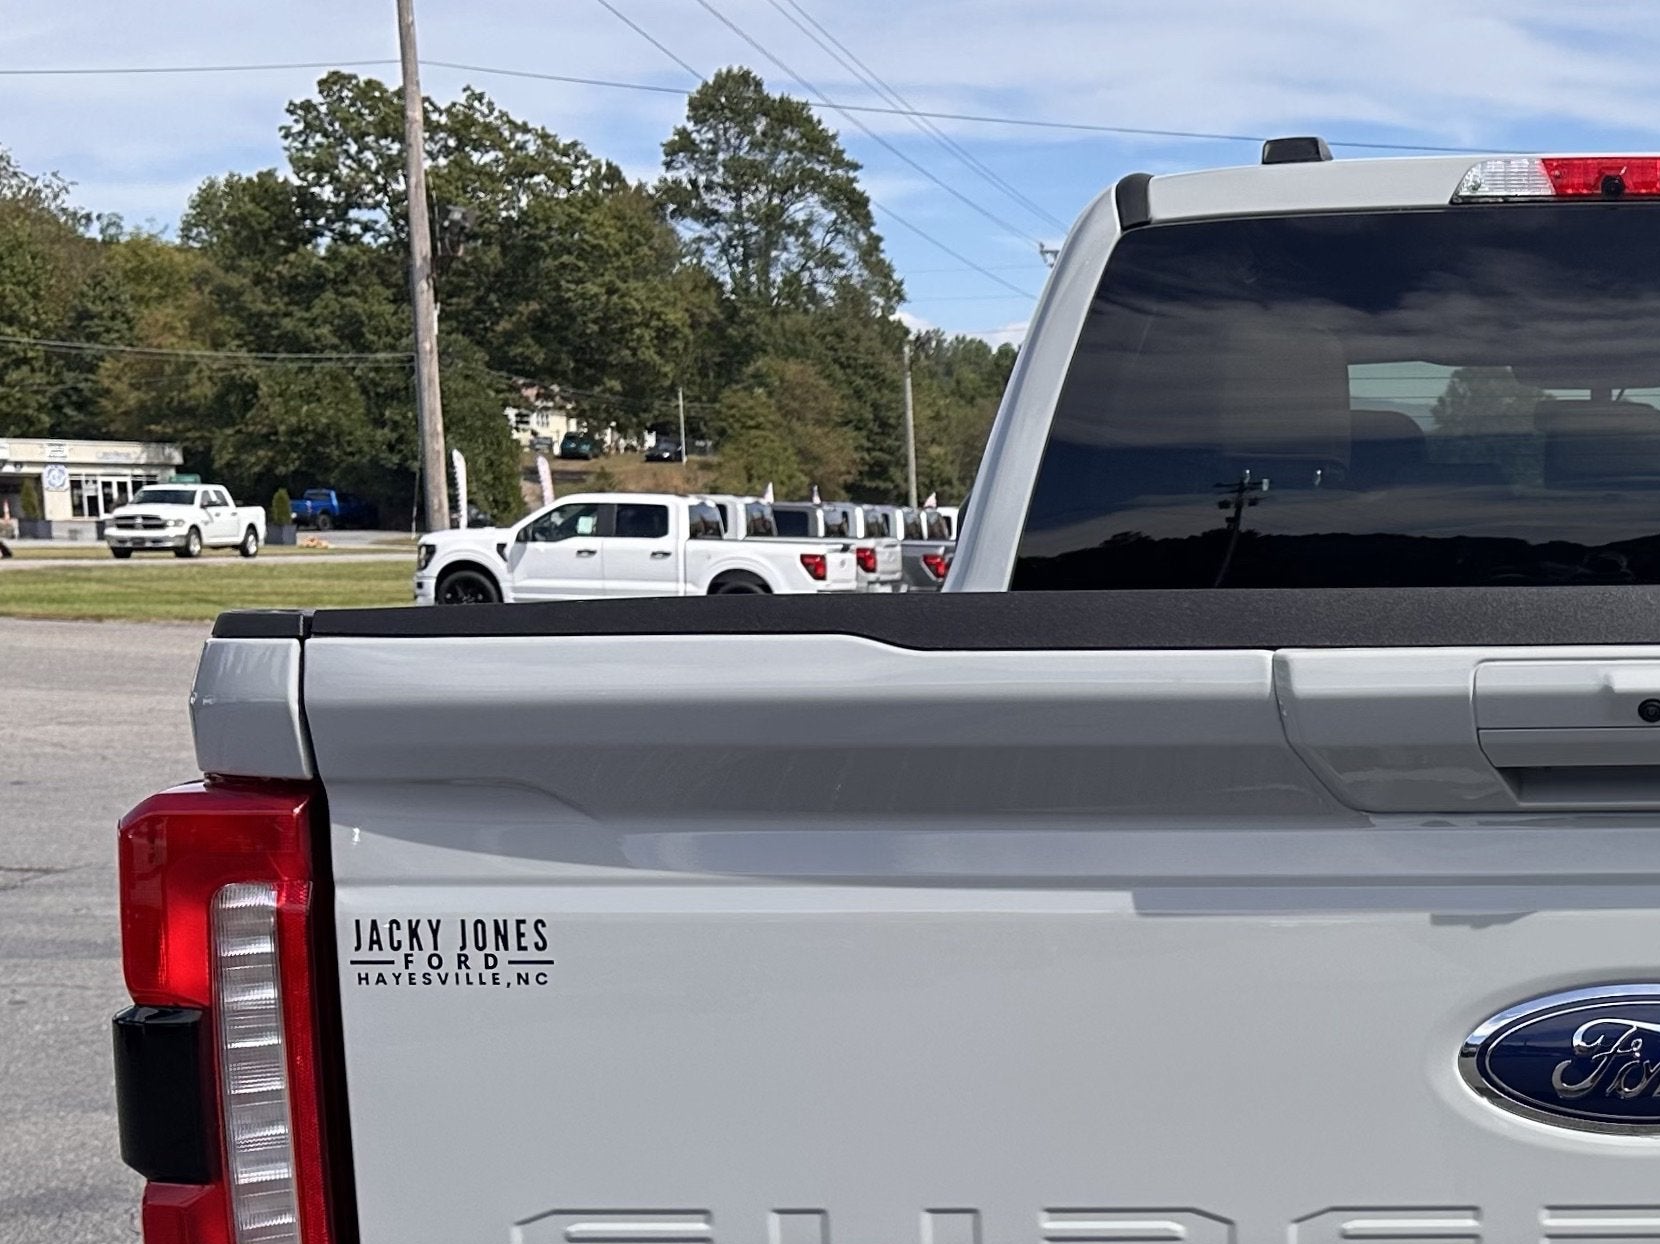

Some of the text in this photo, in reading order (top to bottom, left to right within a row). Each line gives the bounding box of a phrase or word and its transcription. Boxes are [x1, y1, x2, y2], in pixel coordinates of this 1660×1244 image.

[354, 918, 549, 952] JACKY JONES
[403, 952, 499, 971] FORD
